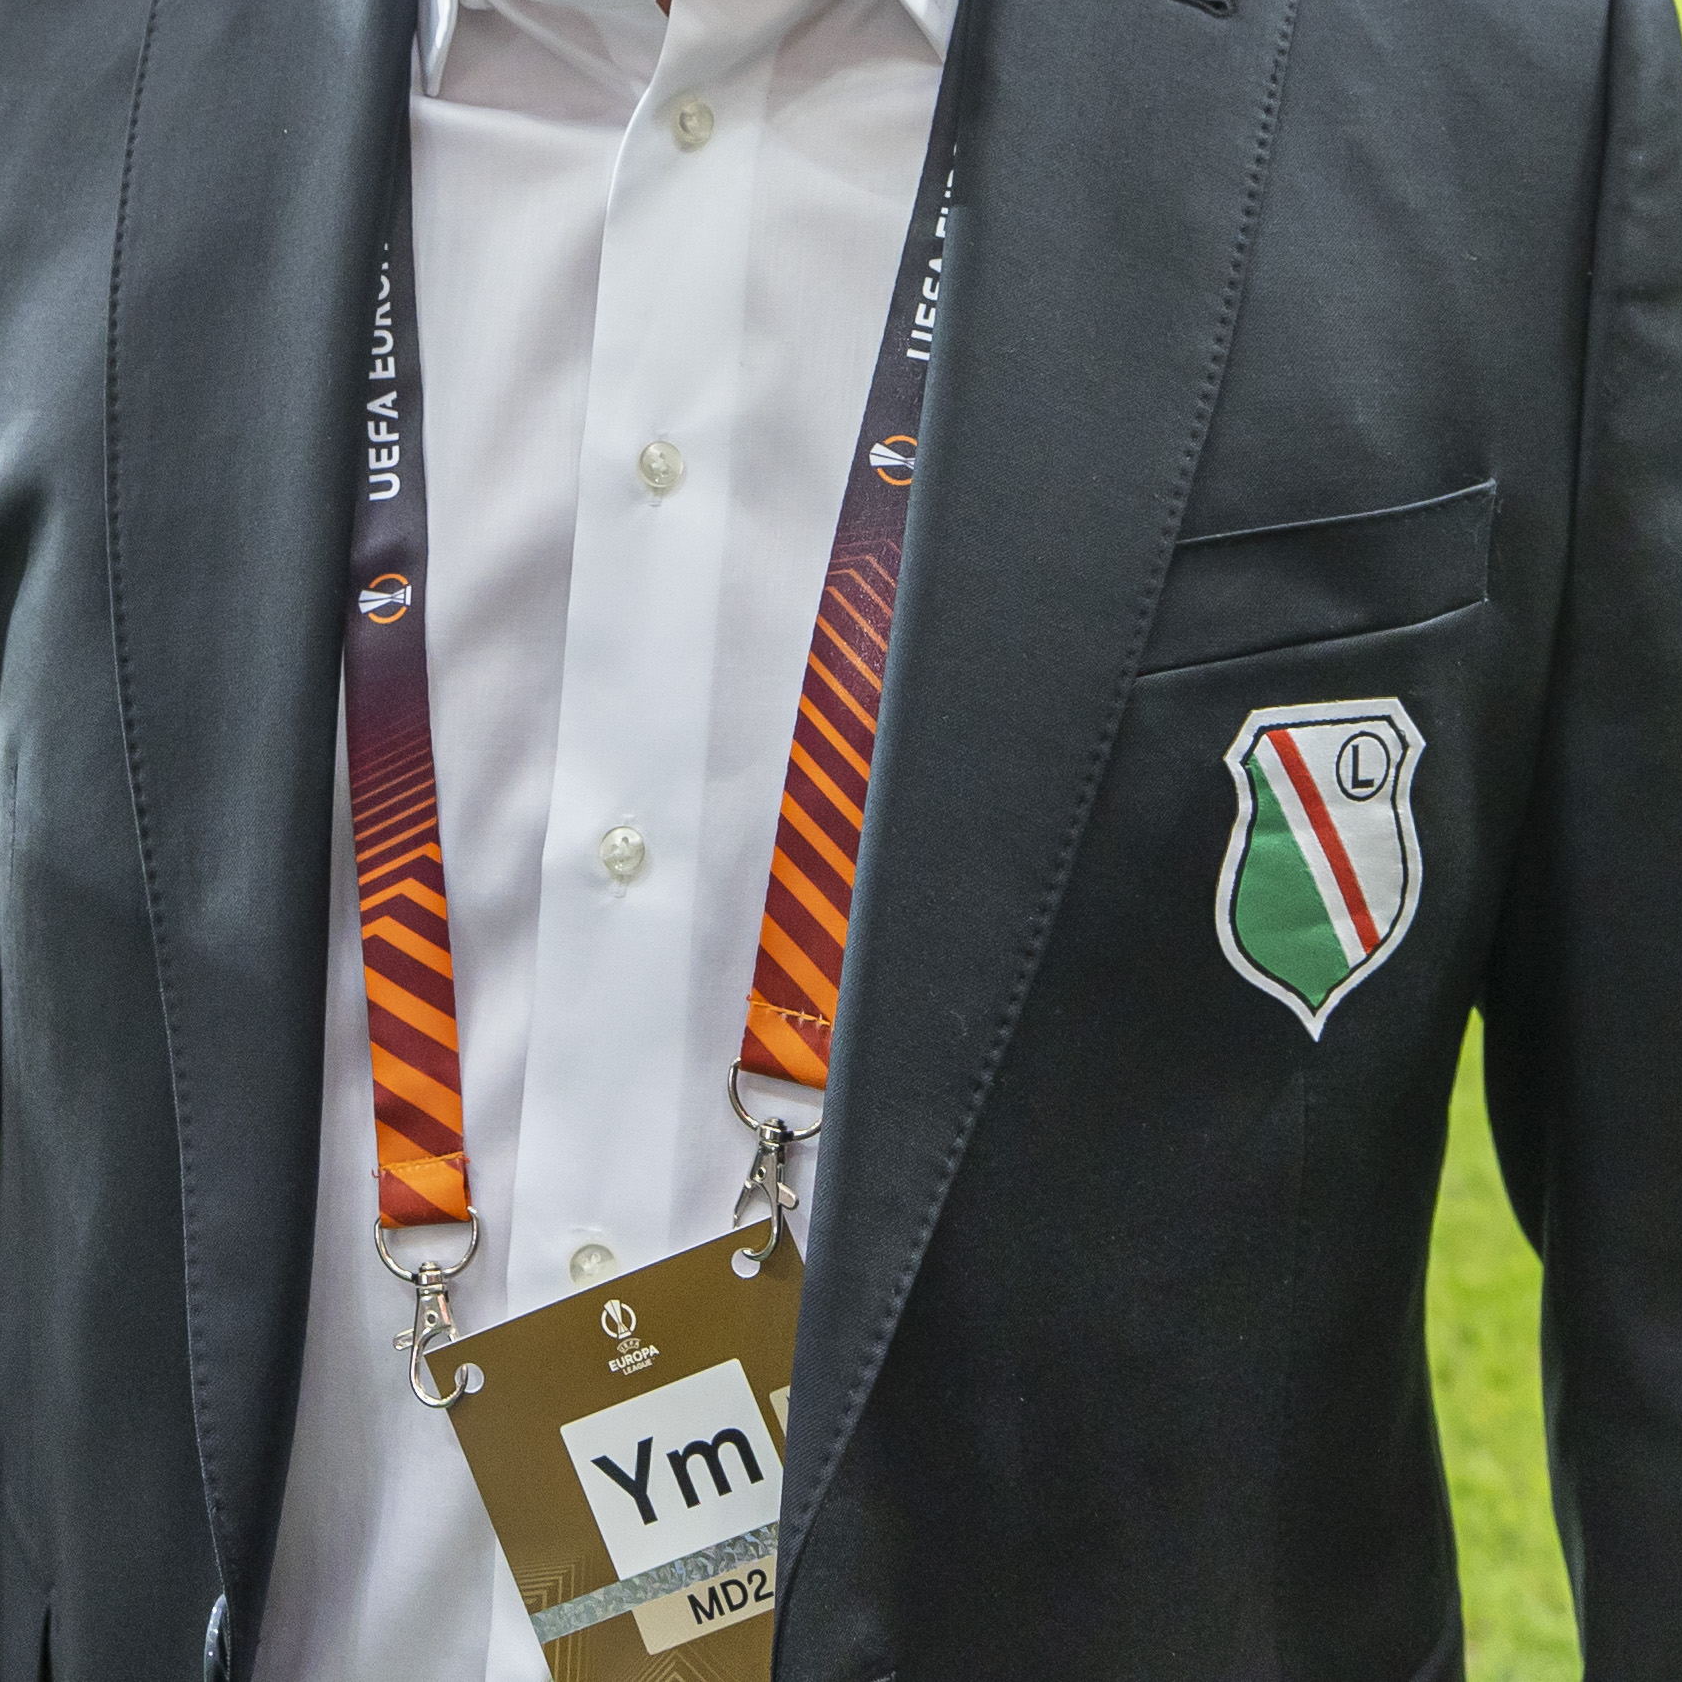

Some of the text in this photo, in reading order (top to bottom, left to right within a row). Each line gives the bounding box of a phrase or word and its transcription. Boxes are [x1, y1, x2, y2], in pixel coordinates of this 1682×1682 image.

[367, 390, 401, 501] UEFA
[1351, 744, 1375, 790] L
[608, 1344, 660, 1373] EUROPA
[622, 1358, 653, 1376] LEAGUE
[591, 1428, 764, 1526] Ym
[686, 1568, 775, 1625] MD2
